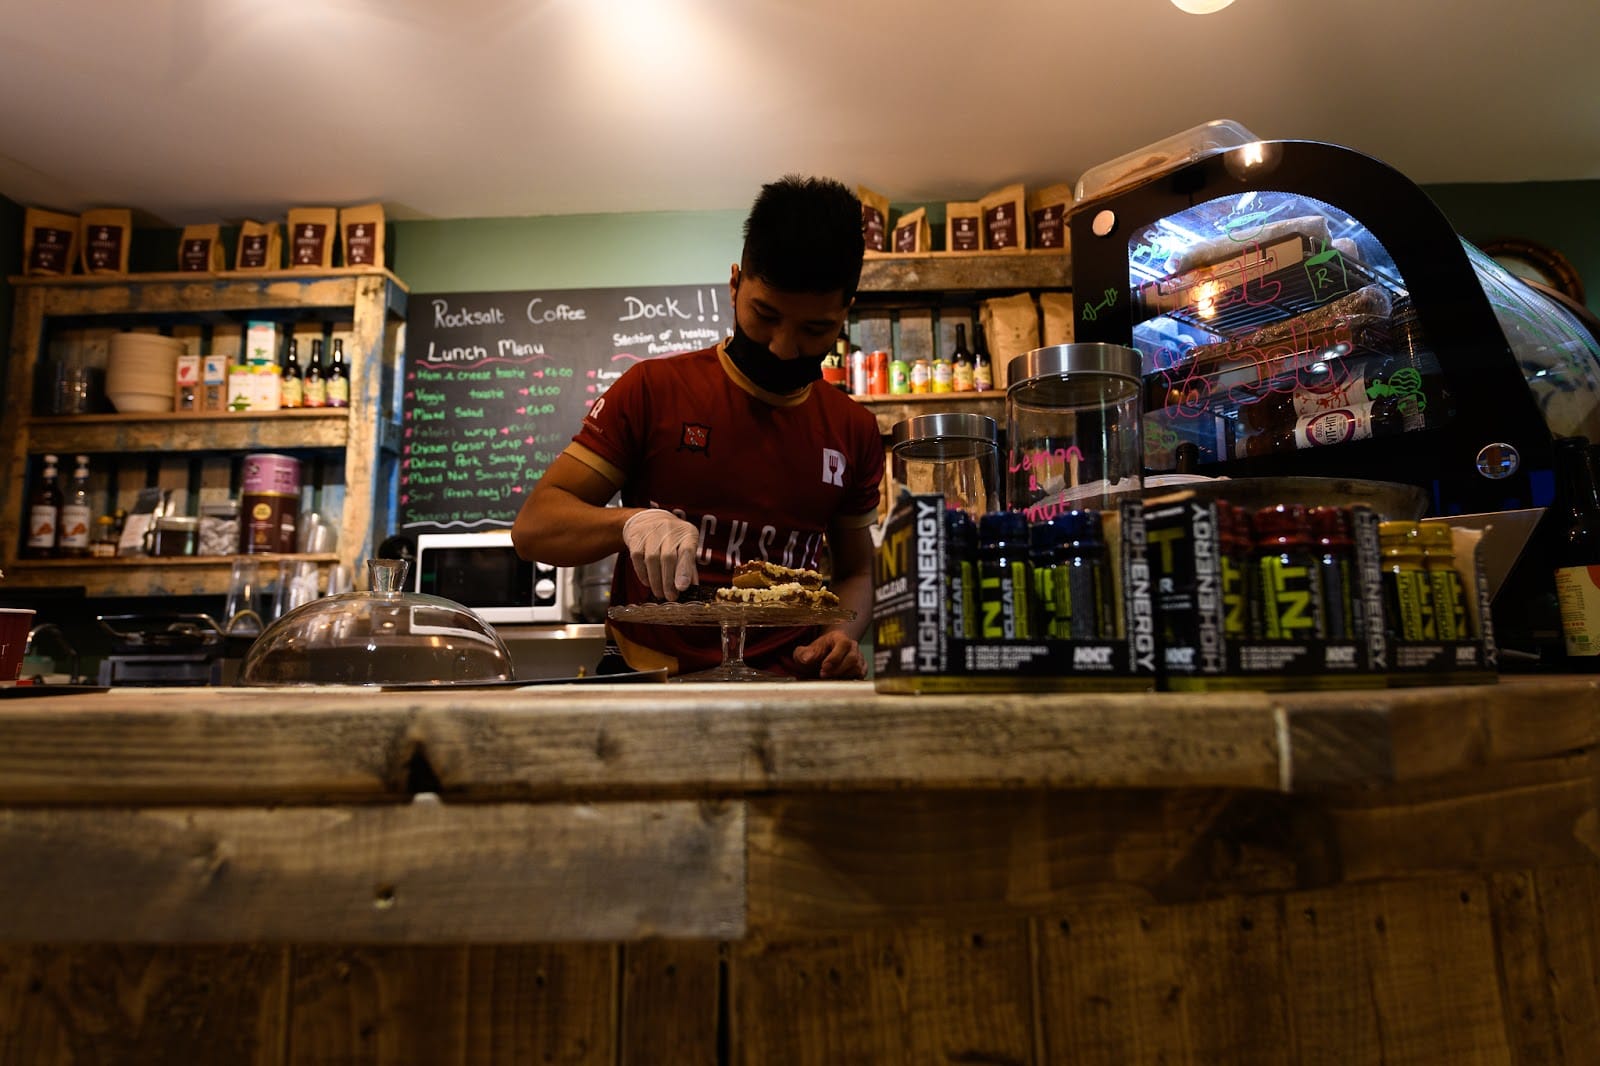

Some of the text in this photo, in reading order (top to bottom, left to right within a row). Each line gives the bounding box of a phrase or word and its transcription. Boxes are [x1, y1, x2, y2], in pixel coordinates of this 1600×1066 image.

[432, 299, 505, 328] Rocksalt
[527, 298, 587, 324] Coffee
[659, 329, 673, 340] of
[428, 339, 544, 362] Lunch Menu
[1009, 446, 1084, 473] Lemon
